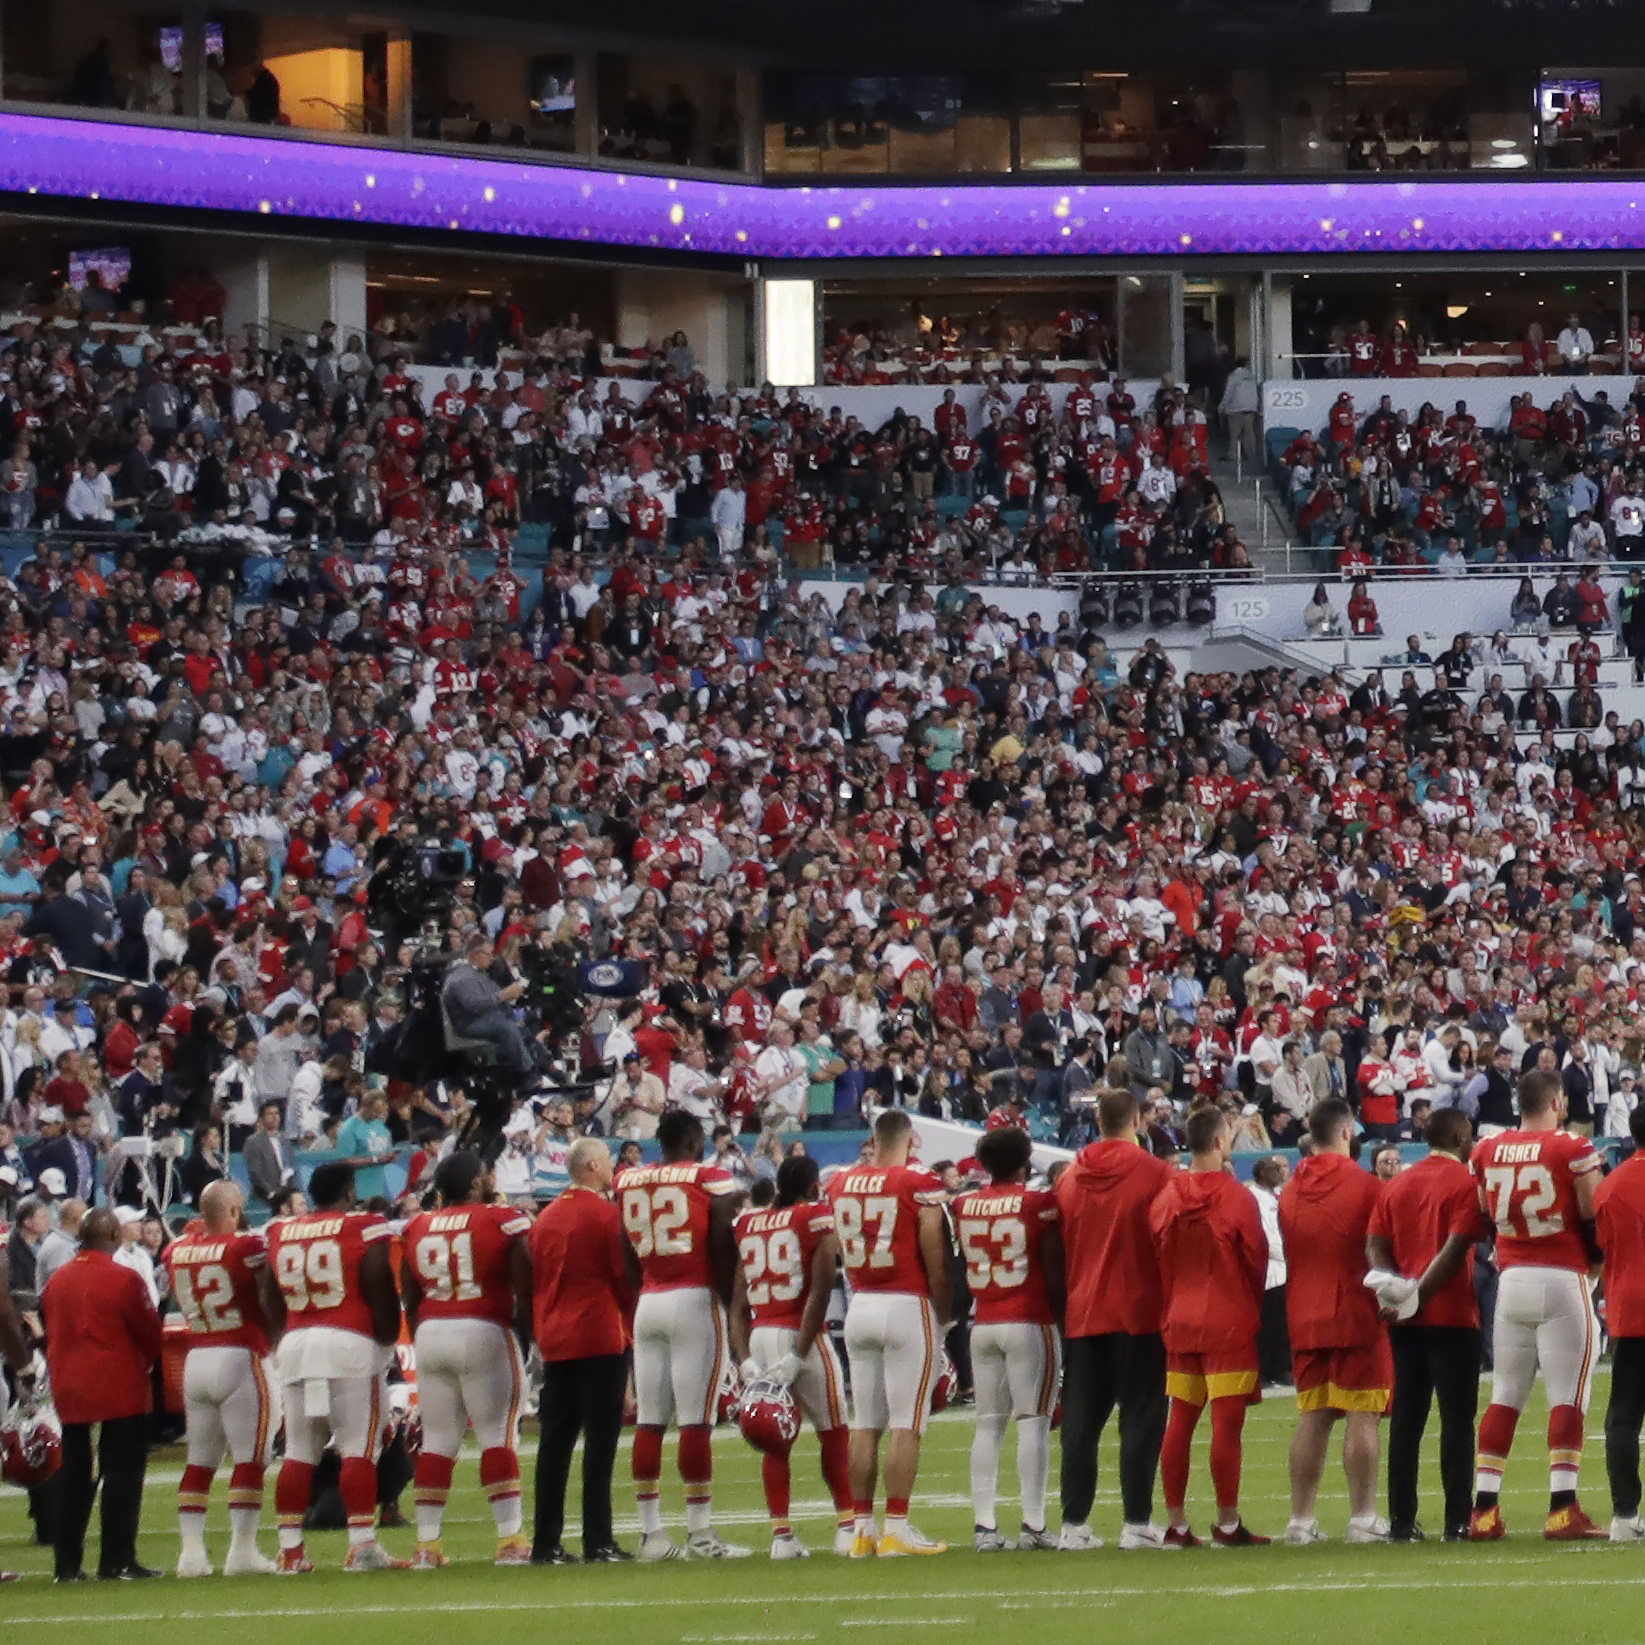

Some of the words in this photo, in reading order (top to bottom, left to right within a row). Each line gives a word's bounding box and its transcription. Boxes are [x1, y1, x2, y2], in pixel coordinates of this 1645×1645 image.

[1271, 390, 1305, 407] 225
[1232, 602, 1265, 617] 125
[1494, 1143, 1541, 1163] FISHER
[844, 1174, 886, 1194] KELCE
[962, 1194, 1023, 1216] HITCHENS
[1484, 1165, 1565, 1239] 72
[280, 1218, 343, 1242] SAUNDERS
[622, 1187, 693, 1257] 92
[747, 1210, 791, 1230] FULLER
[834, 1195, 899, 1270] 87
[172, 1242, 225, 1262] SHERMAN
[416, 1239, 482, 1302] 91
[739, 1230, 803, 1306] 29
[961, 1218, 1028, 1288] 53
[277, 1239, 344, 1311] 99
[173, 1265, 242, 1333] 42
